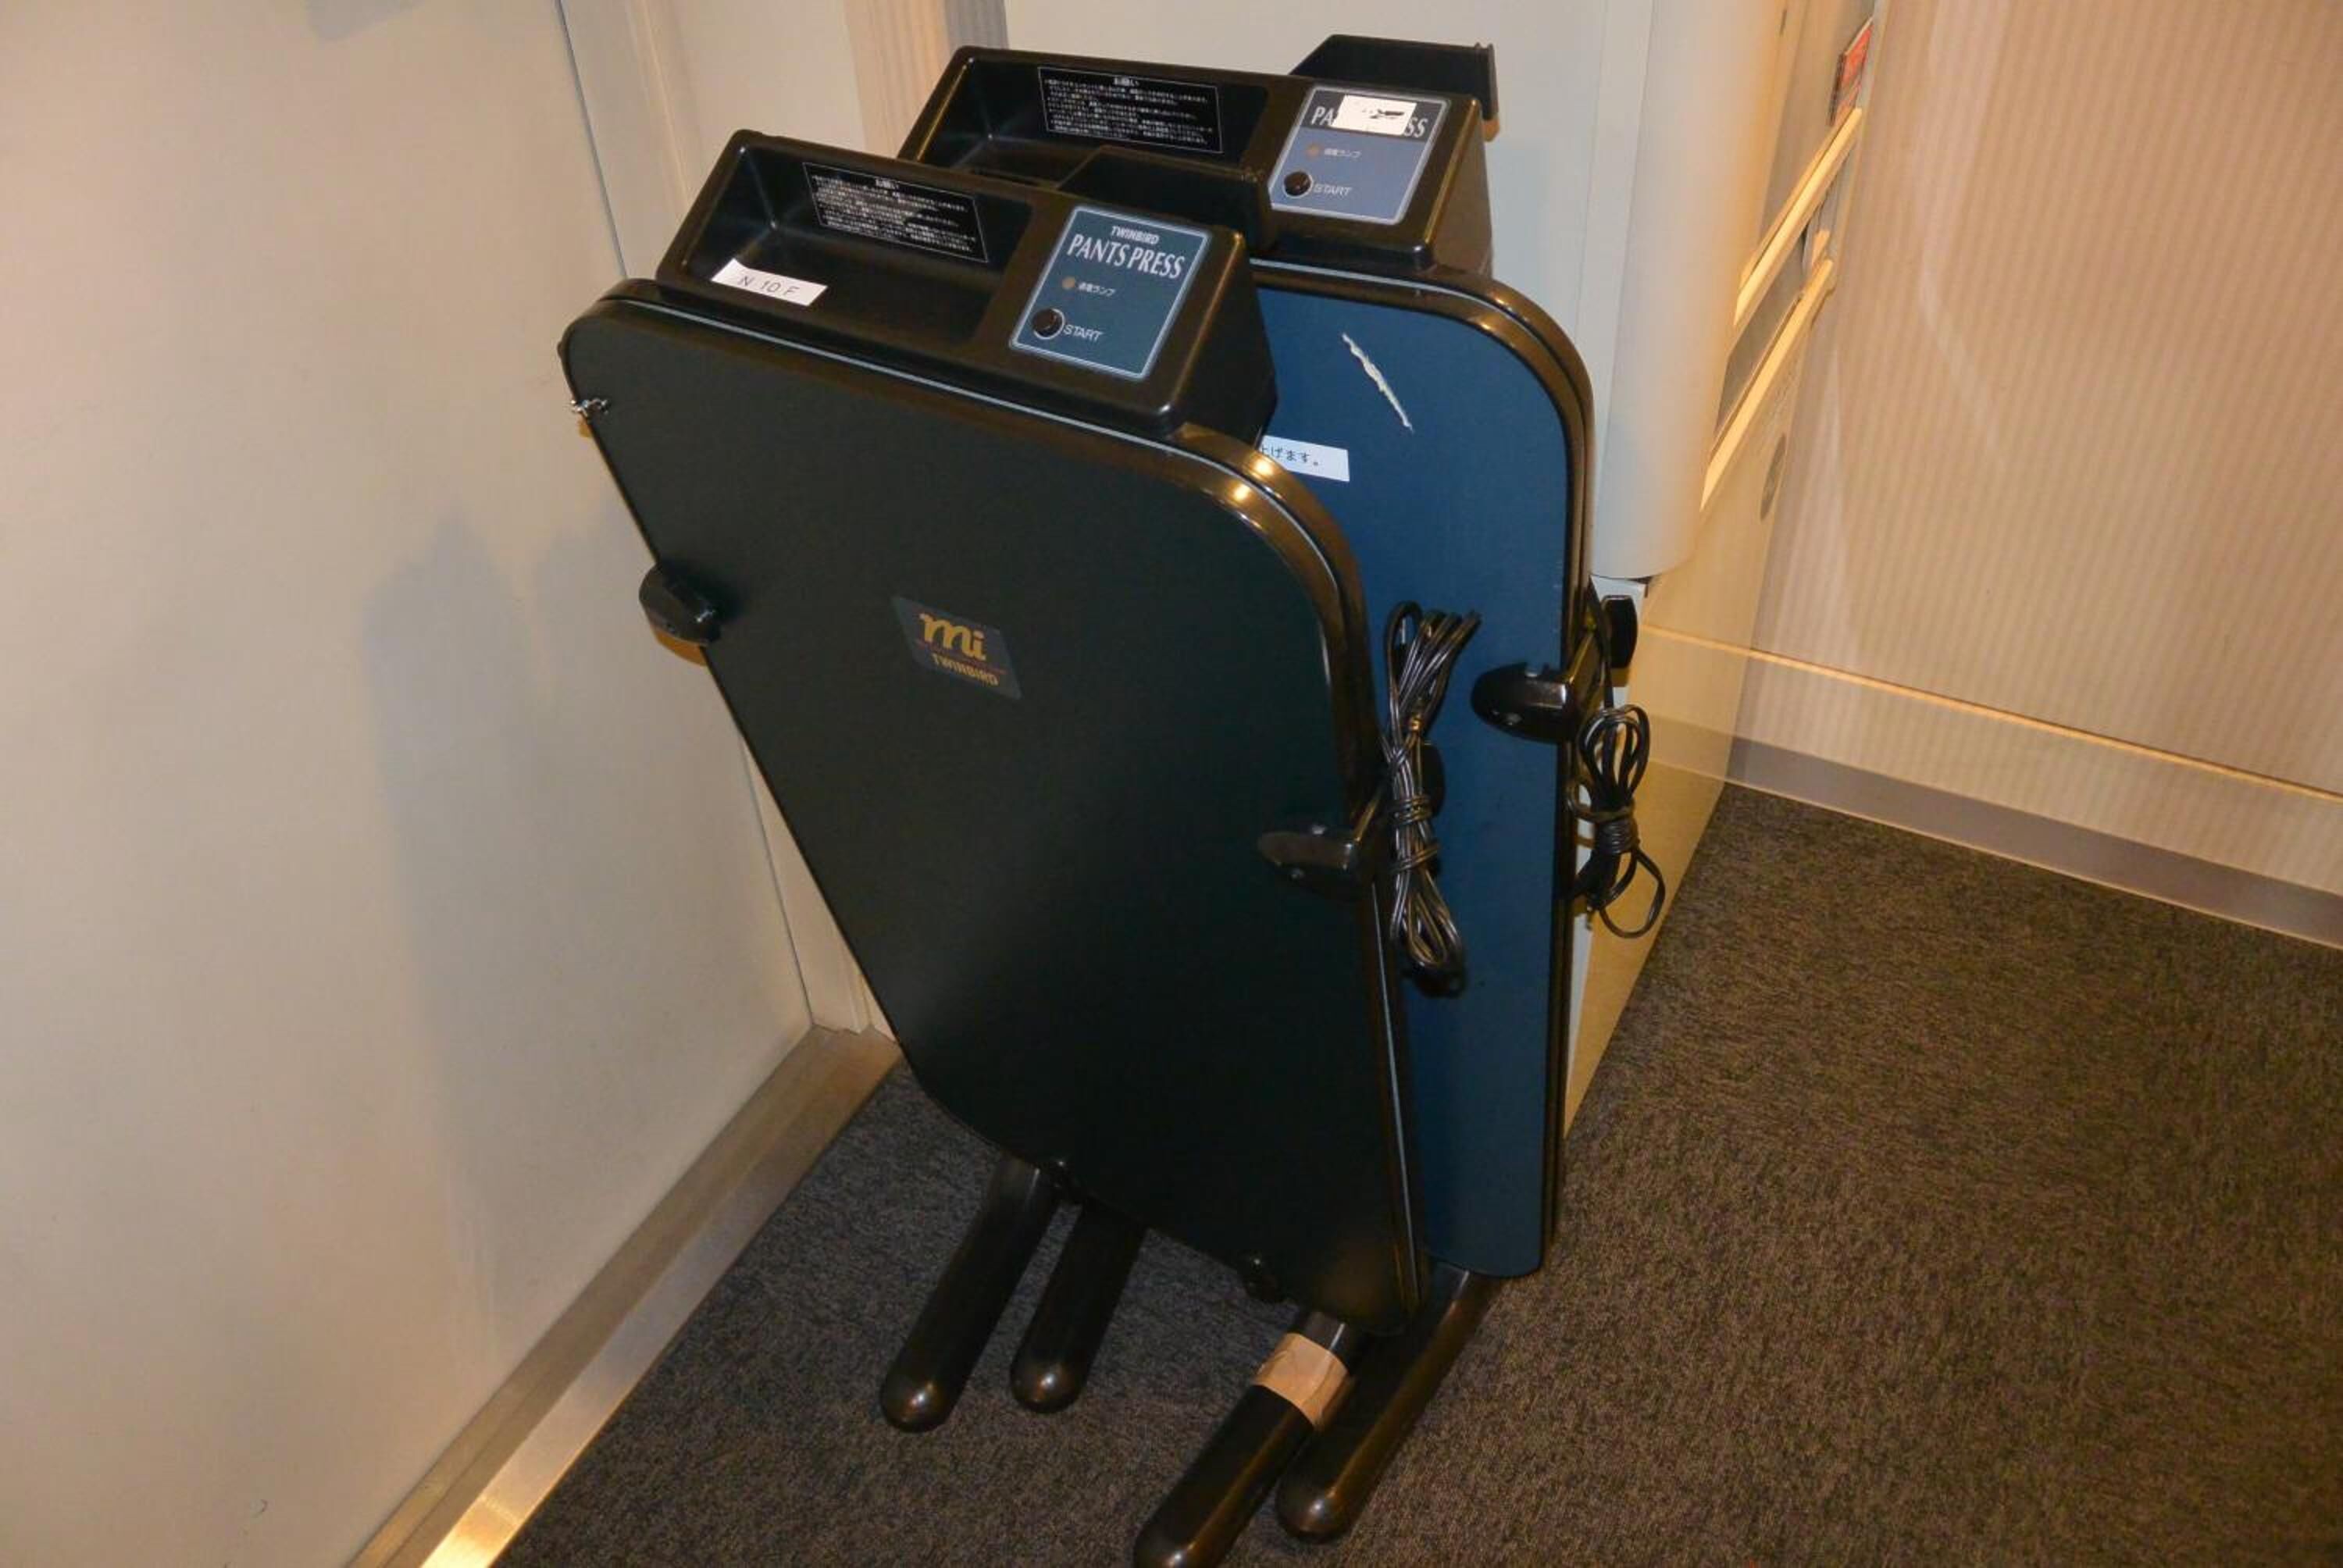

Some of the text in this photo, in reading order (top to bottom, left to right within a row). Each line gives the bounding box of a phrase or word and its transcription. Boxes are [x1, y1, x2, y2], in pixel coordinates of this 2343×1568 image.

[1312, 183, 1353, 198] START
[1110, 225, 1161, 245] TWINBIRD
[1067, 233, 1186, 280] PANTS PRESS
[737, 276, 753, 287] N
[1063, 324, 1104, 342] START
[918, 612, 986, 661] mi
[932, 653, 999, 686] TWINBIRD
